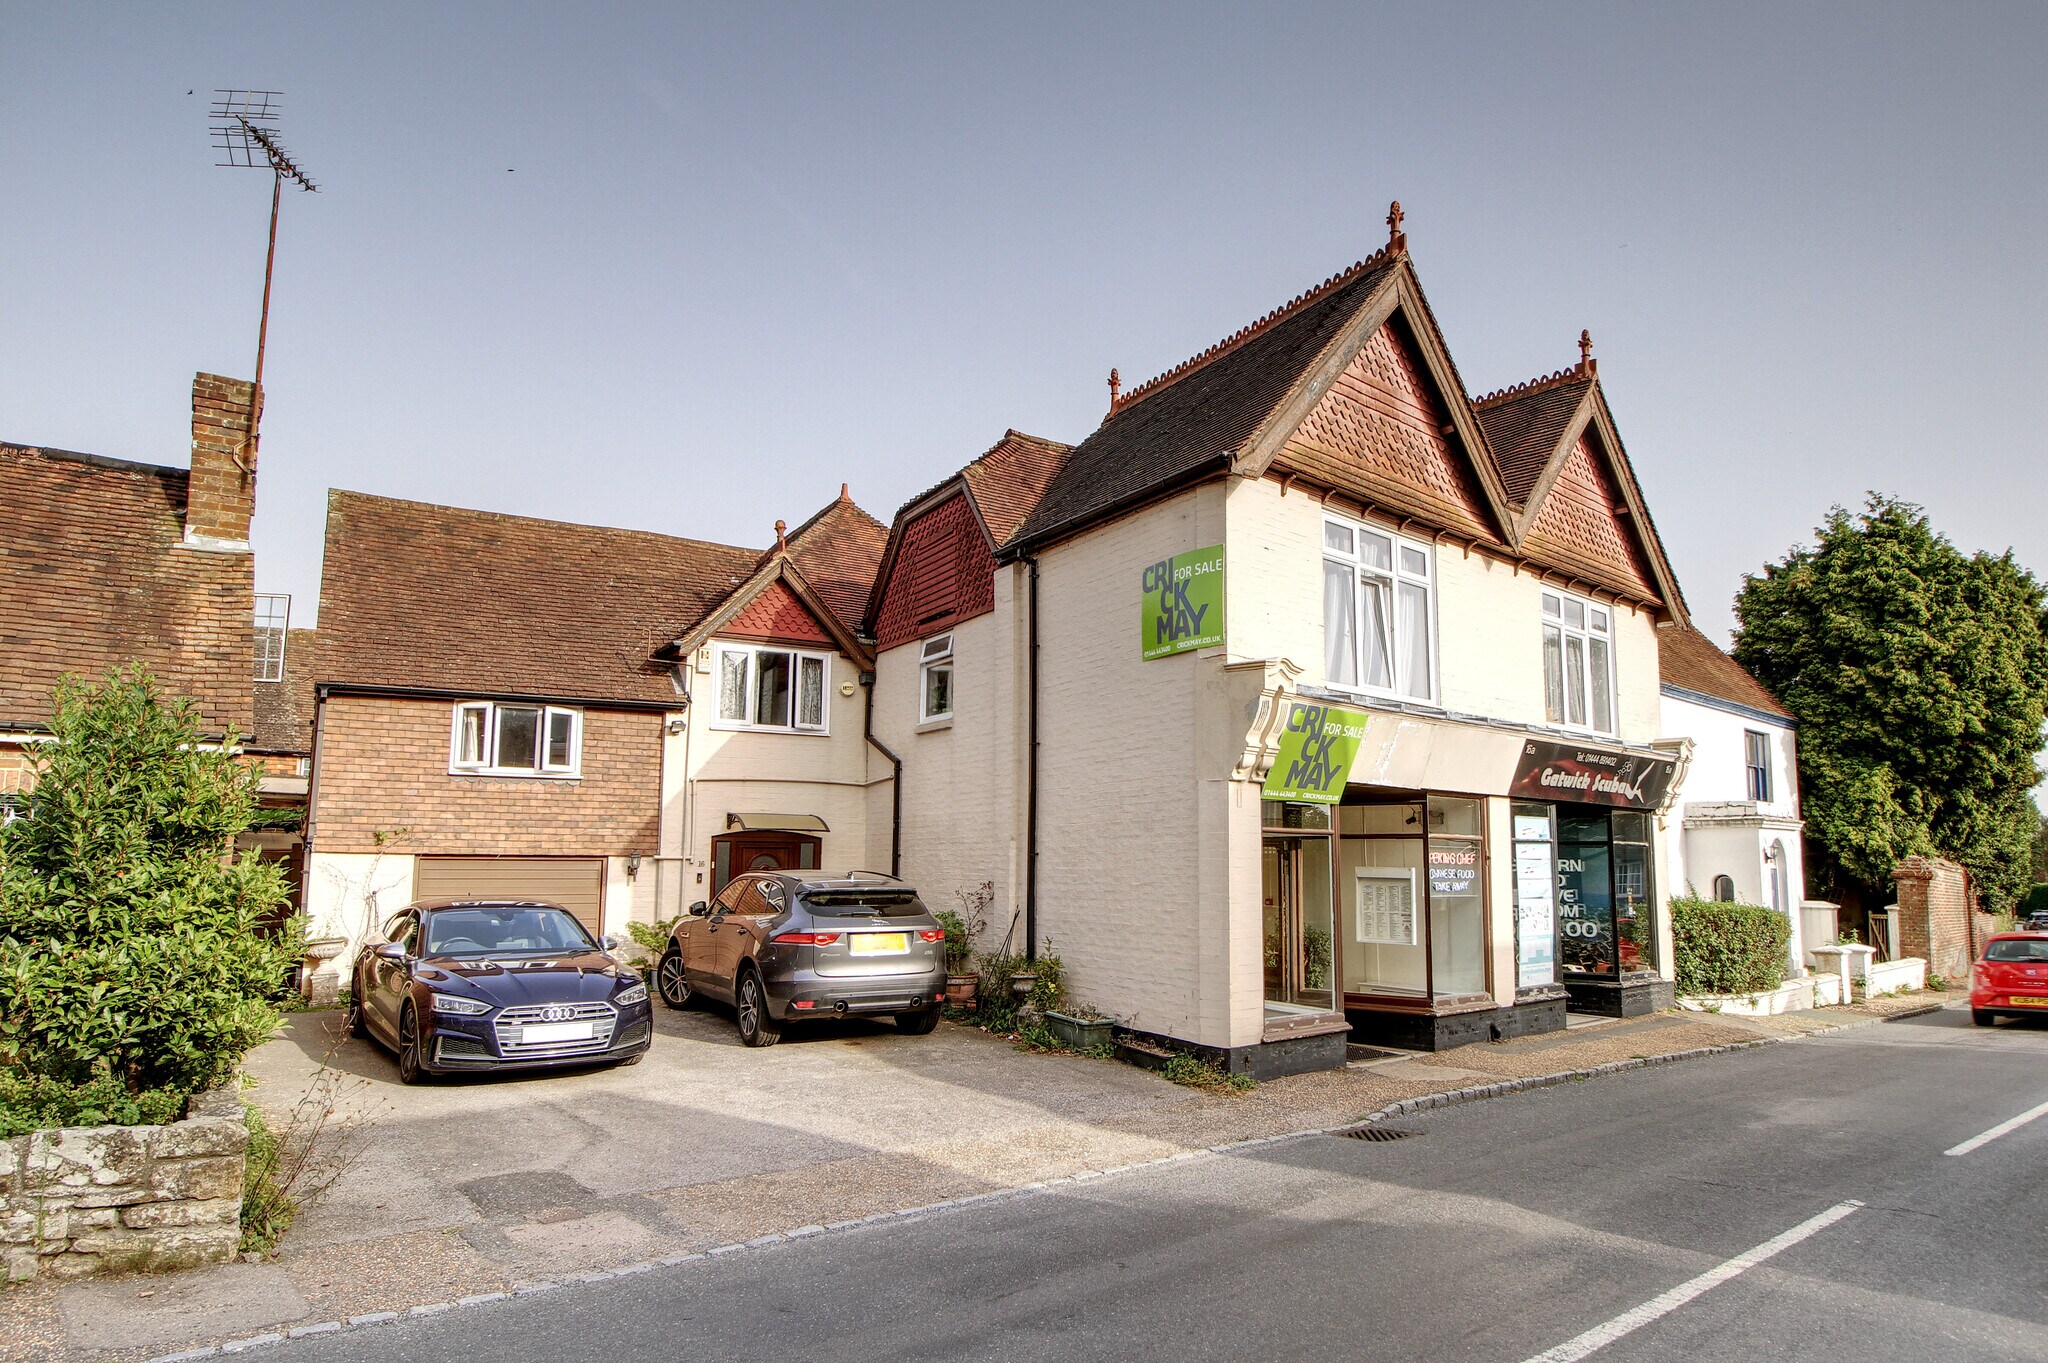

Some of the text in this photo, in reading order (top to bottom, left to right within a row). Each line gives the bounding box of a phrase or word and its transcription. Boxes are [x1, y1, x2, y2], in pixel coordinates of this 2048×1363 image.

[1174, 559, 1222, 580] FOR SALE
[1176, 635, 1221, 649] CRICKMAY.CO.UK
[1323, 722, 1364, 738] FOR SALE
[1540, 767, 1629, 794] Gatwick Scuba
[1302, 792, 1340, 801] CRICKMAY.CO.UK
[1429, 852, 1476, 864] PEKING CHEF
[1457, 869, 1475, 878] FOOD
[1432, 880, 1471, 891] TAKE AWAY
